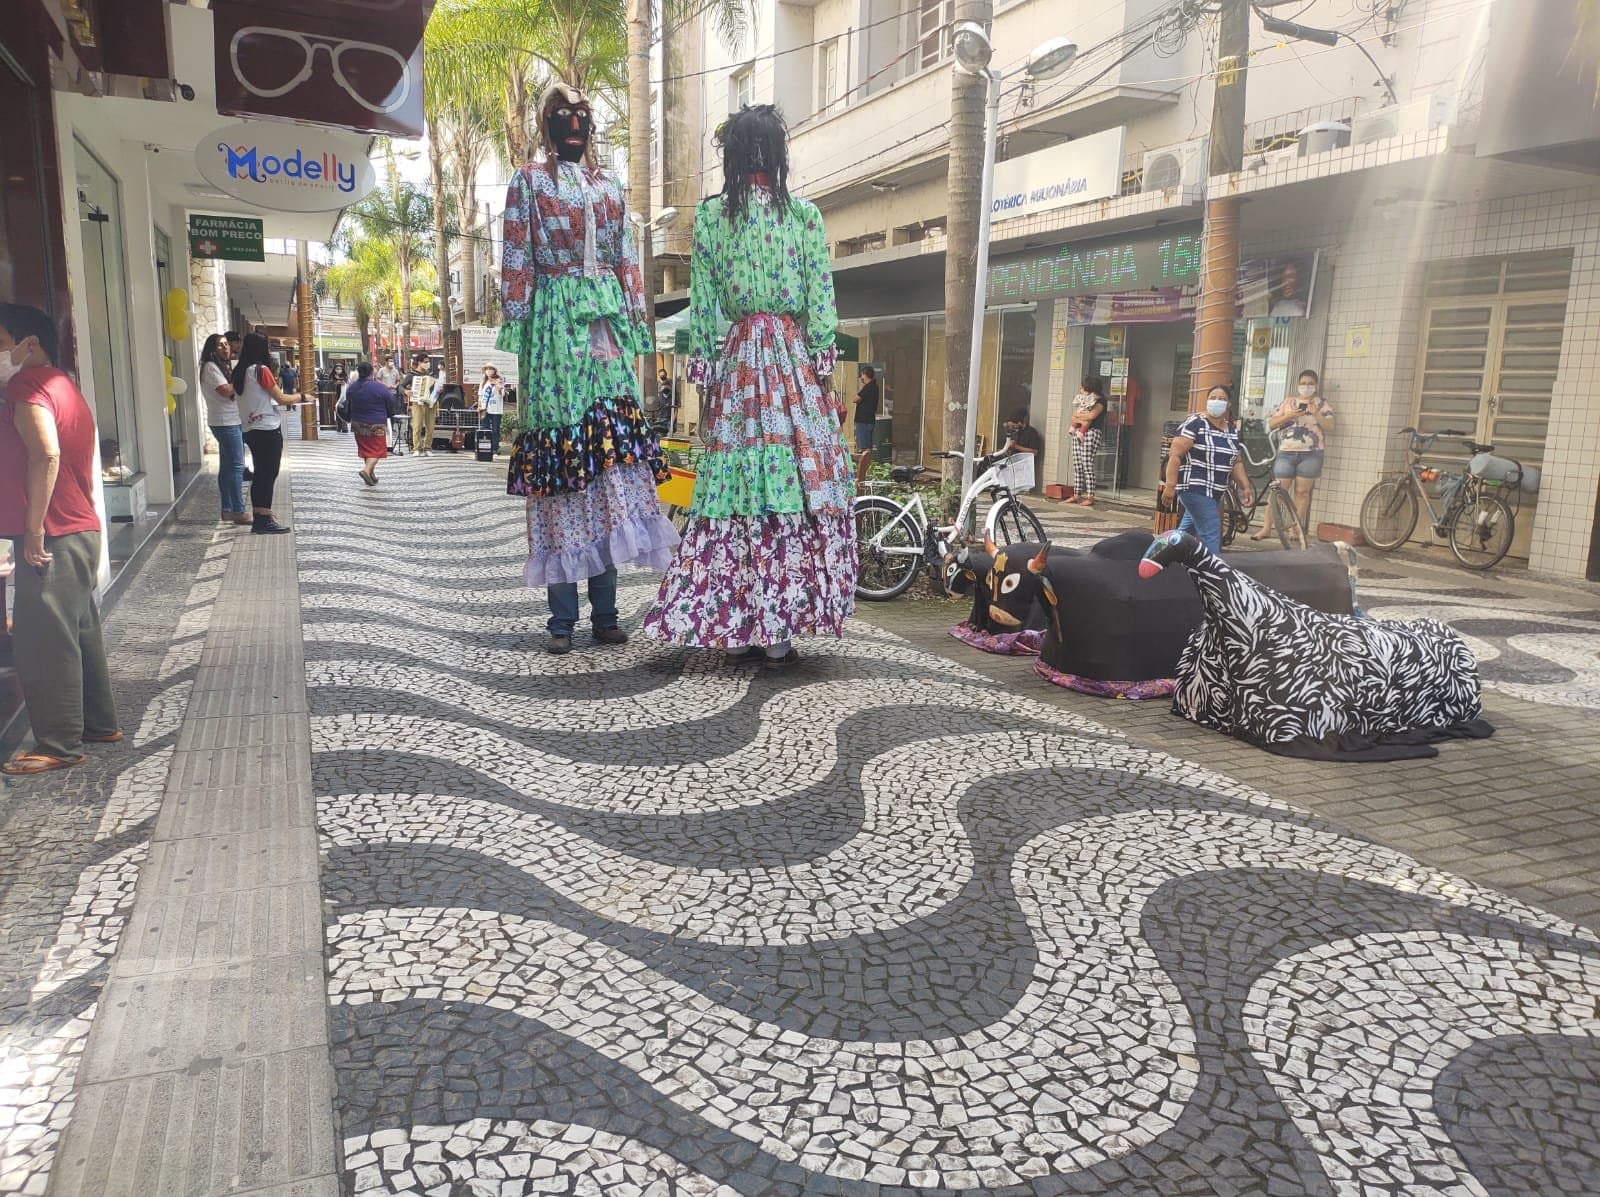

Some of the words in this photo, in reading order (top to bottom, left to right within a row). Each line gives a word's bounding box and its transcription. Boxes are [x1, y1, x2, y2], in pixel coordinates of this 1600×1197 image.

[217, 142, 355, 192] Modelly
[195, 219, 257, 230] FARMÁCIA
[192, 228, 218, 238] BOM
